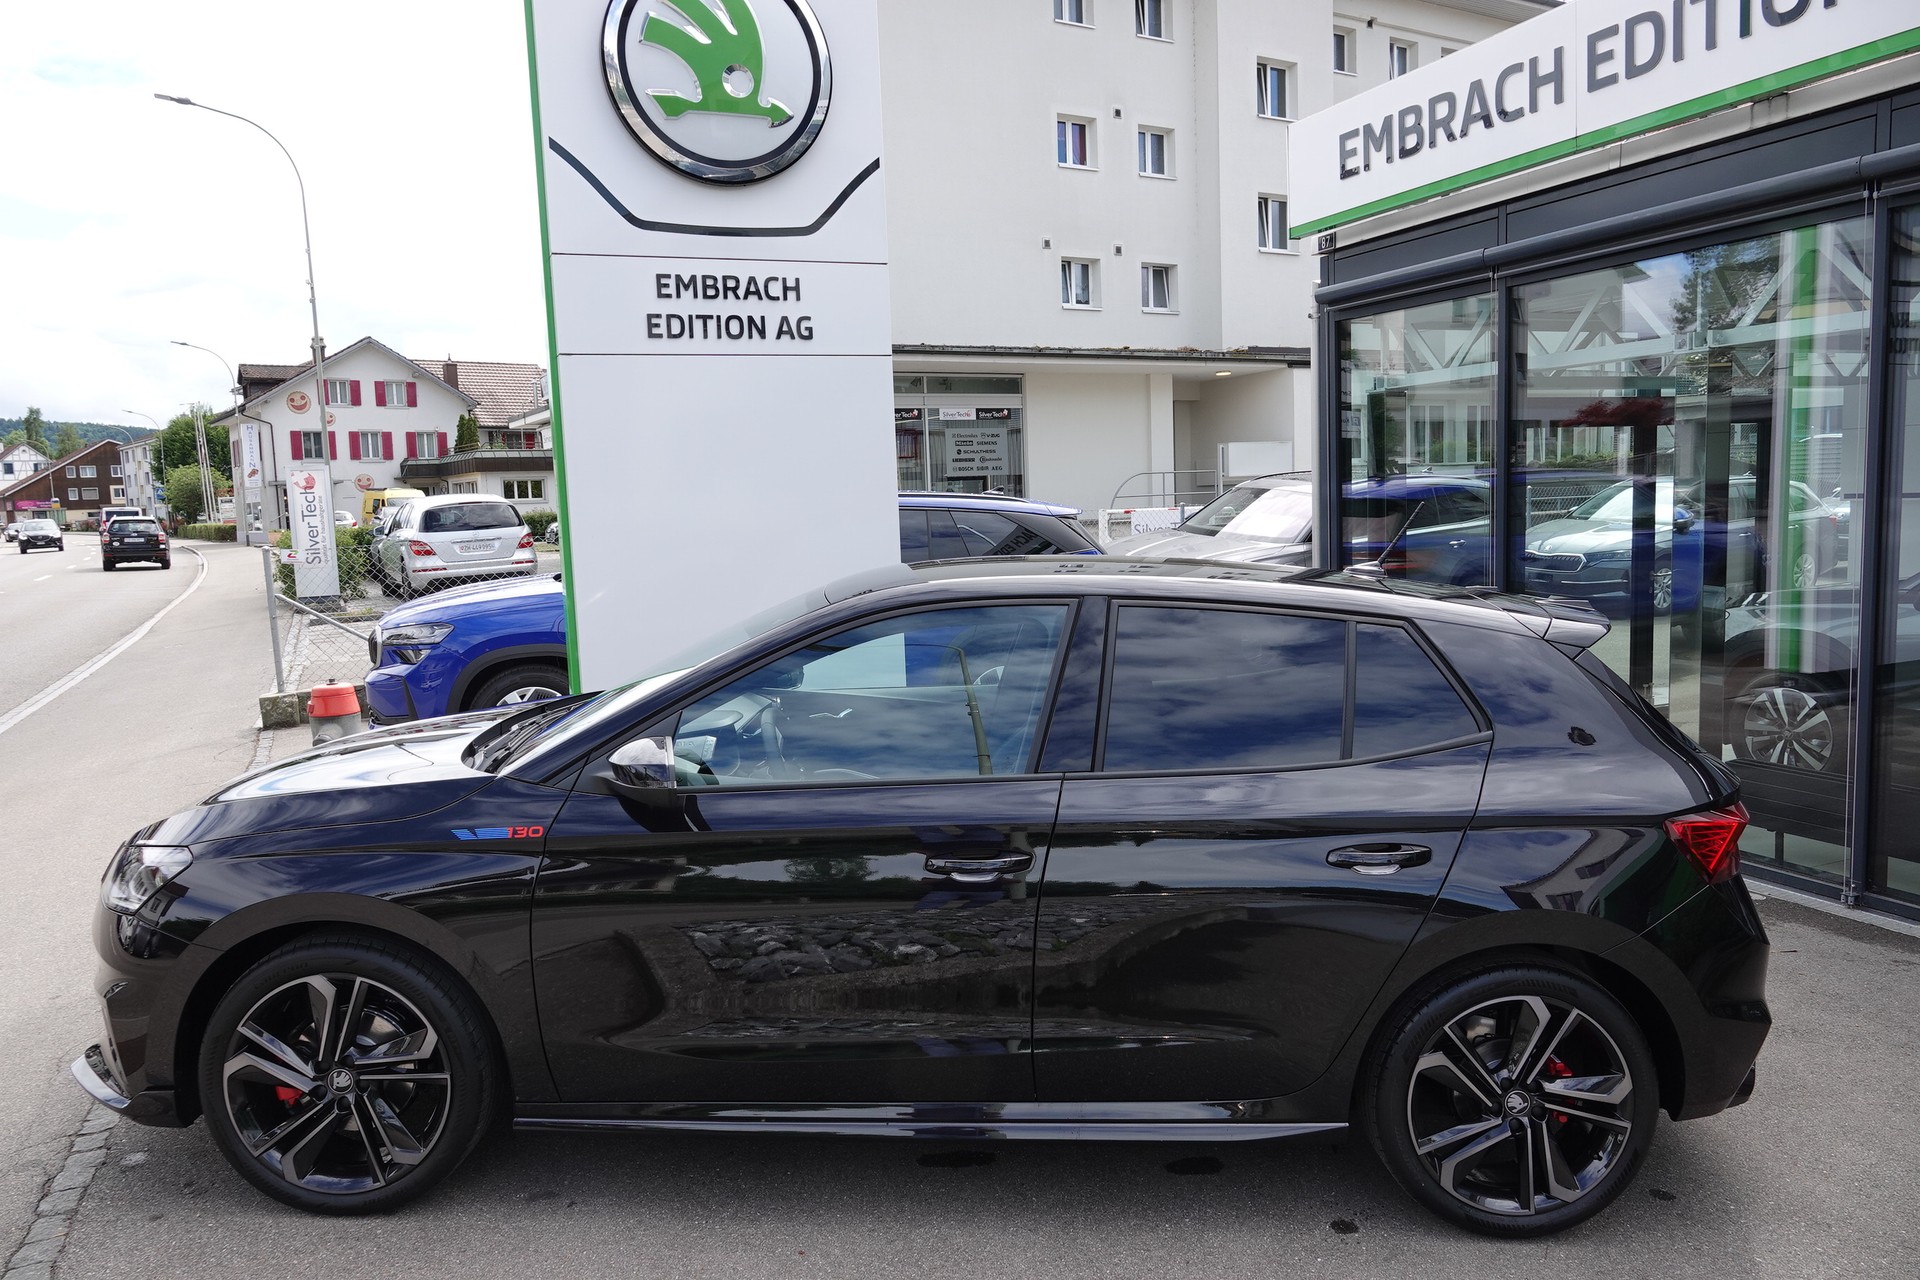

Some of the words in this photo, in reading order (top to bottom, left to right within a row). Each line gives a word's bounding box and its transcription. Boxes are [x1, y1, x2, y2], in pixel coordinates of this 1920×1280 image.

[1339, 46, 1565, 180] EMBRACH
[1321, 236, 1331, 249] 87
[656, 273, 801, 301] EMBRACH
[646, 313, 767, 340] EDITION
[775, 316, 814, 340] AG
[507, 826, 544, 838] 130
